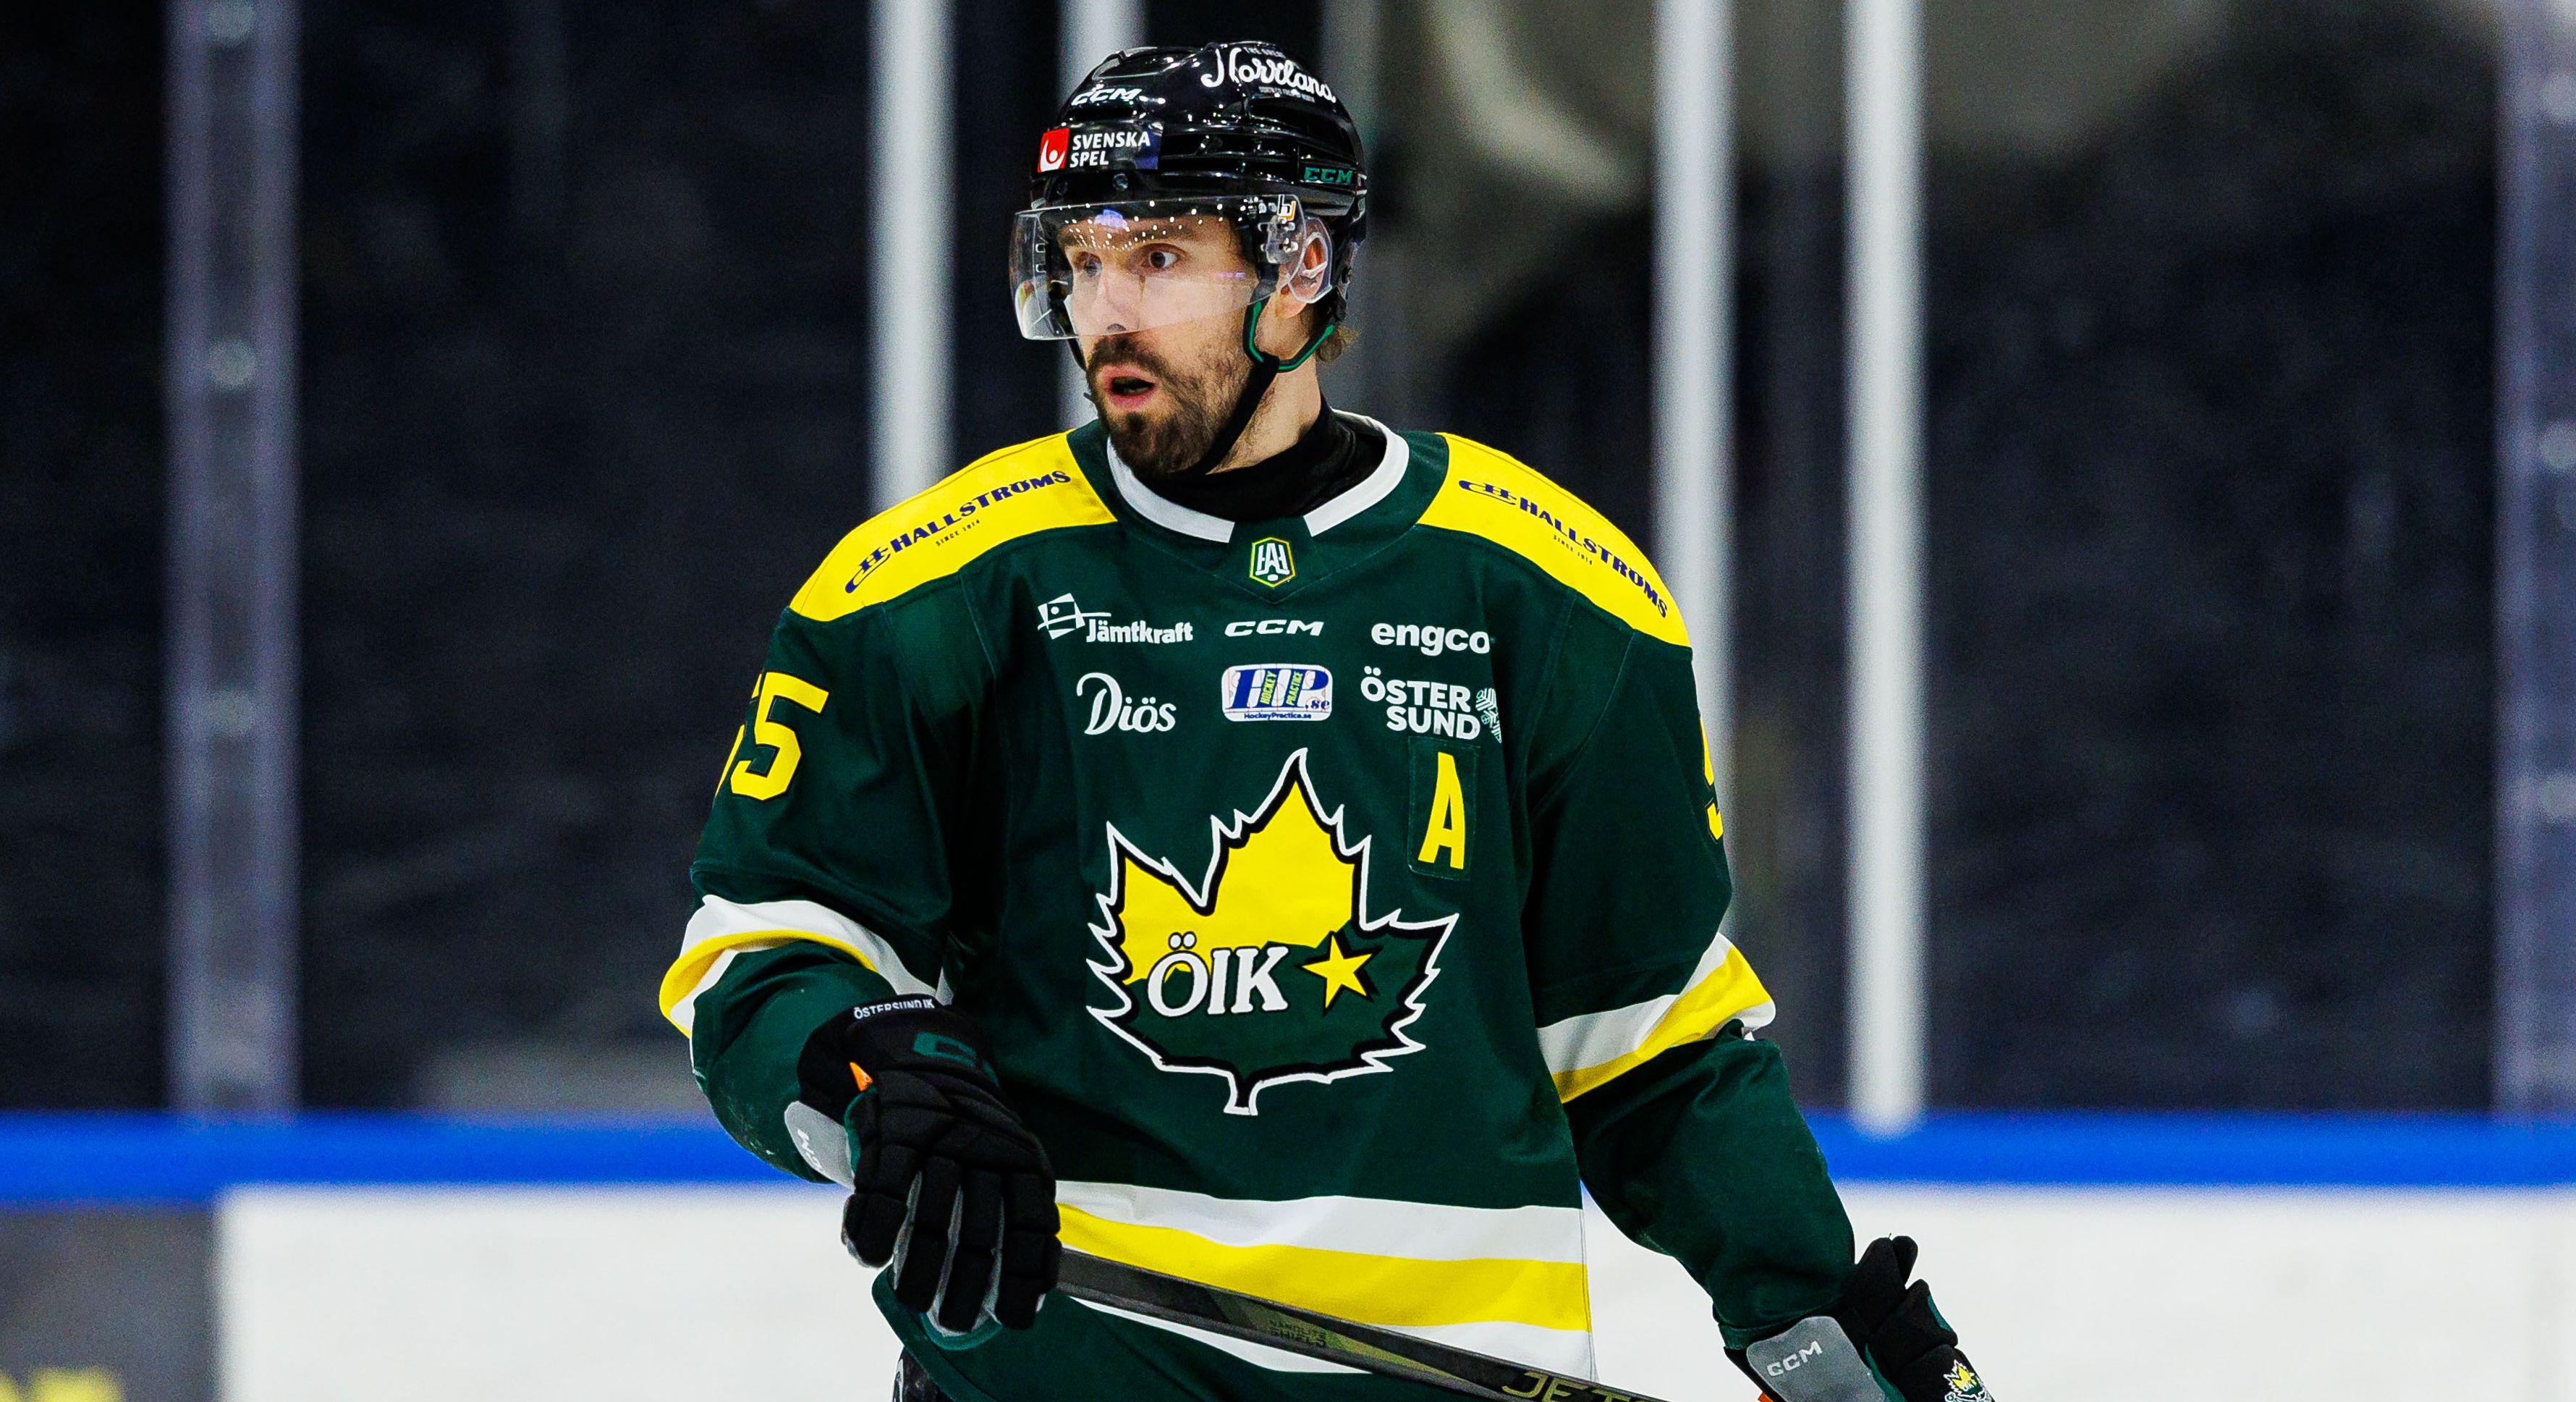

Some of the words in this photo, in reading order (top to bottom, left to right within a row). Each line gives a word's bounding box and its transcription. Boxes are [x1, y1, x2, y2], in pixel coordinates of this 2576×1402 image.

[1071, 88, 1143, 106] CCM
[1072, 131, 1151, 151] SVENSKA
[1069, 151, 1109, 168] SPEL
[1303, 166, 1353, 185] CCM
[1085, 618, 1194, 644] Jämtkraft
[1224, 619, 1324, 637] CCM
[1077, 672, 1177, 735] Diös
[1360, 665, 1471, 714] ÖSTER
[712, 672, 830, 801] 5
[1386, 705, 1481, 740] SUND
[1418, 751, 1466, 870] A
[1148, 932, 1289, 1018] ÖIK
[1767, 1340, 1823, 1377] CCM
